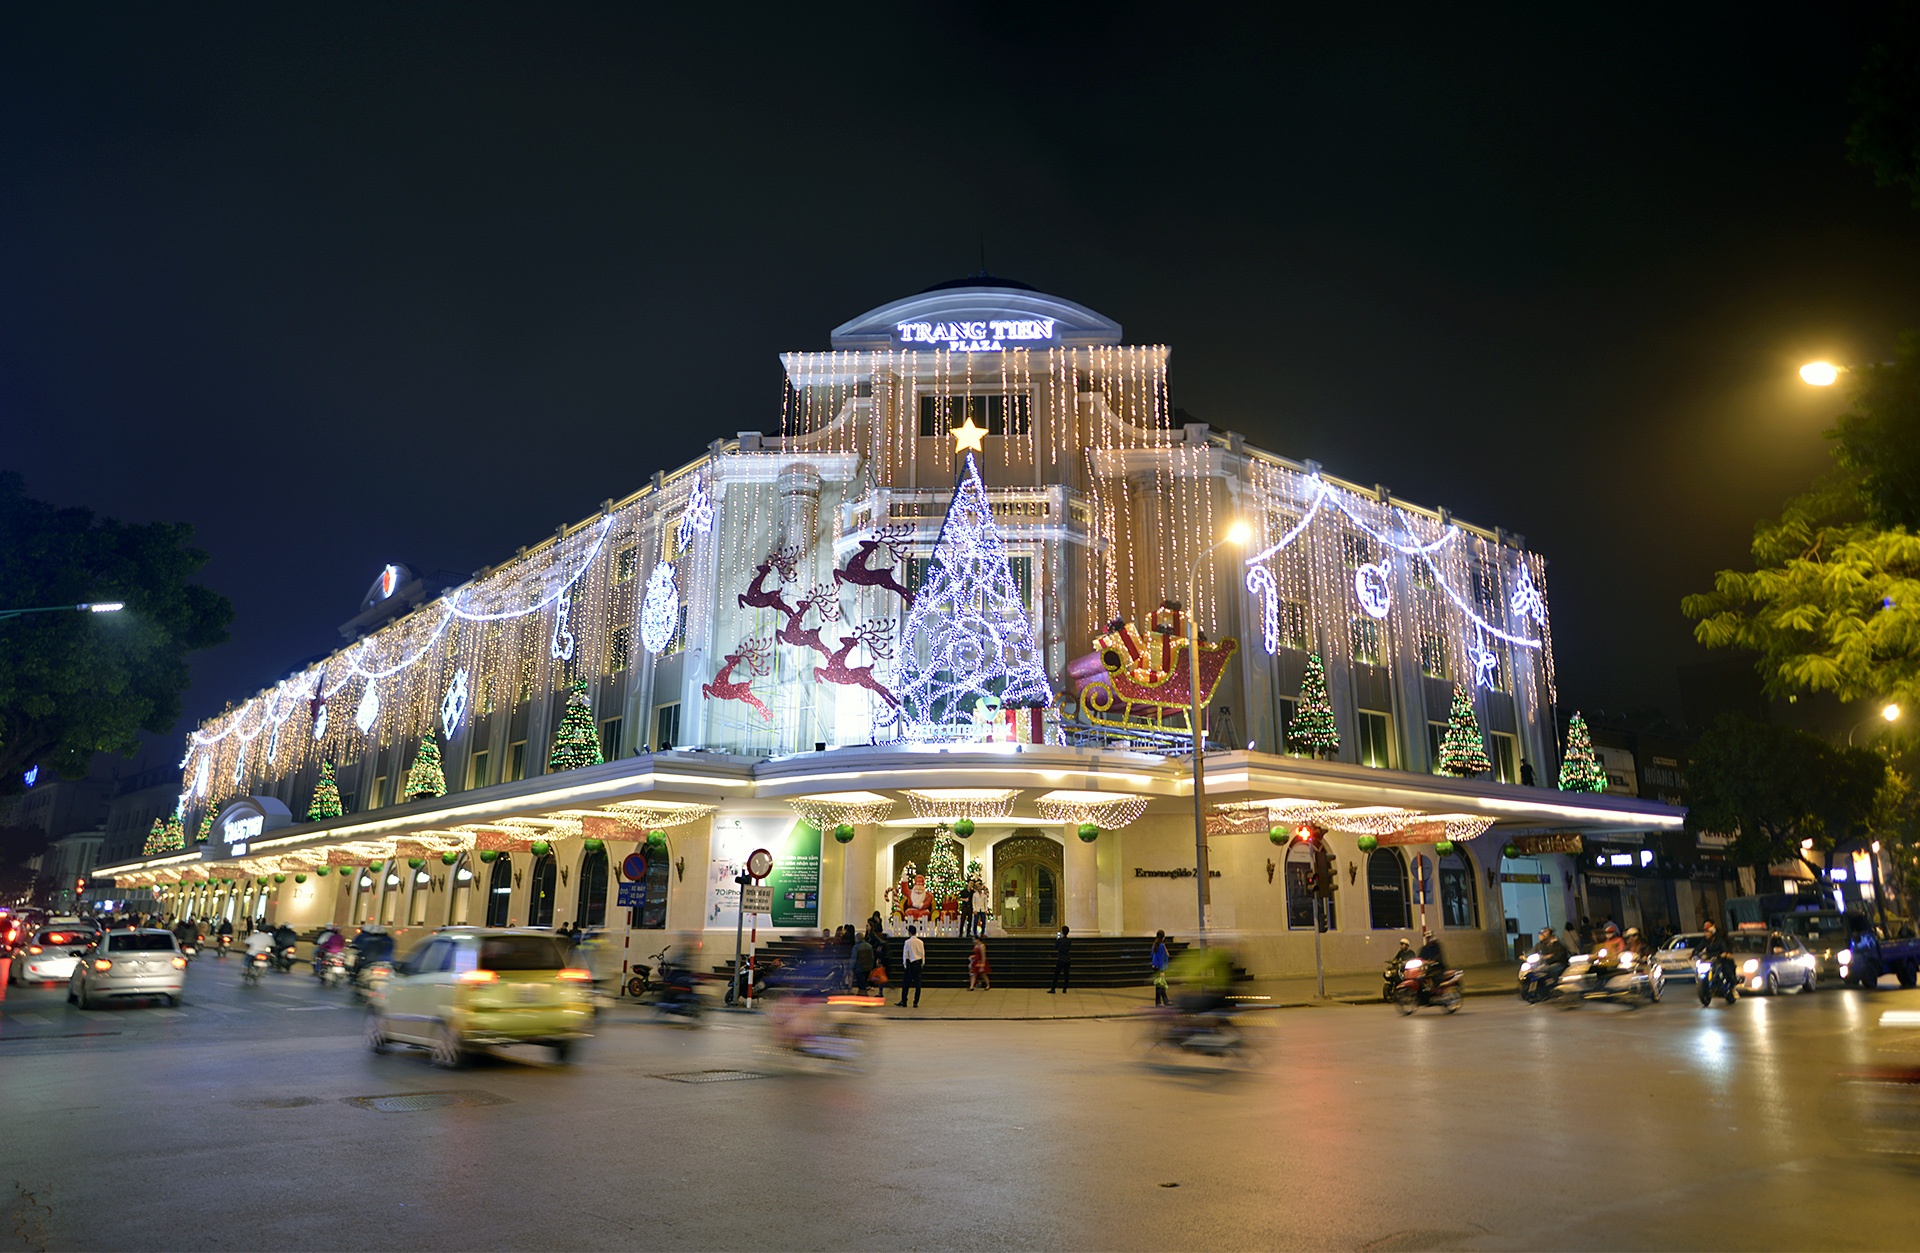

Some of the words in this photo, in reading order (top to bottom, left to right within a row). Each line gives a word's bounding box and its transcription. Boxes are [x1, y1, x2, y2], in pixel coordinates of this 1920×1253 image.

[949, 340, 1002, 351] PLAZA
[1135, 867, 1192, 879] Ermenegildo
[1192, 868, 1221, 878] Zna
[715, 888, 726, 896] 70
[726, 888, 741, 896] iPho
